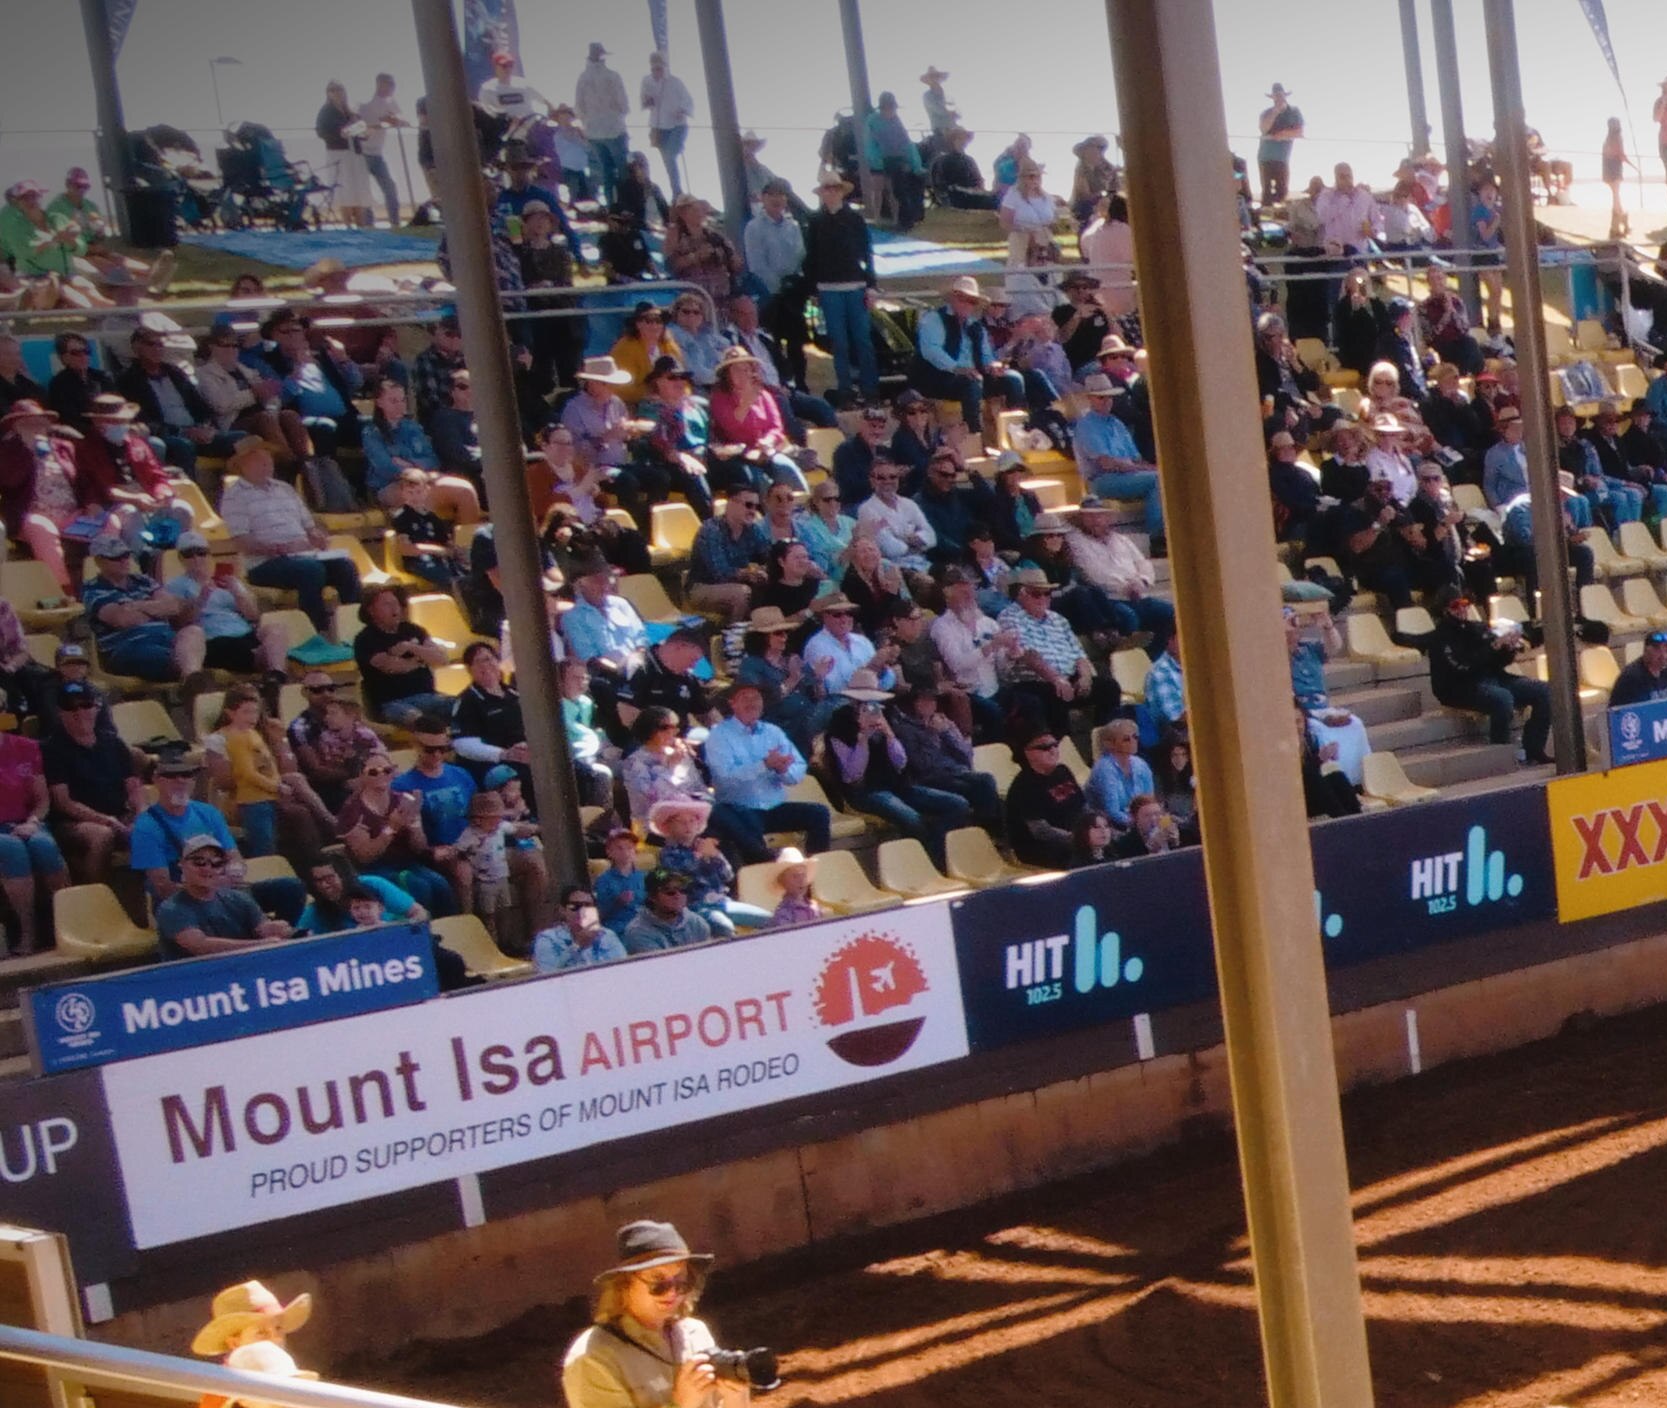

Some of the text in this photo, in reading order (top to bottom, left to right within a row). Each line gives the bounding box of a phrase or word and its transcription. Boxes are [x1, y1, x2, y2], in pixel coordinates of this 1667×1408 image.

[1411, 852, 1464, 900] HIT
[122, 954, 424, 1034] Mount Isa Mines
[1006, 934, 1070, 990] HIT
[1026, 982, 1063, 1006] 102.5
[160, 990, 794, 1165] Mount Isa AIRPORT
[250, 1051, 801, 1199] PROUD SUPPORTERS OF MOUNT ISA RODEO
